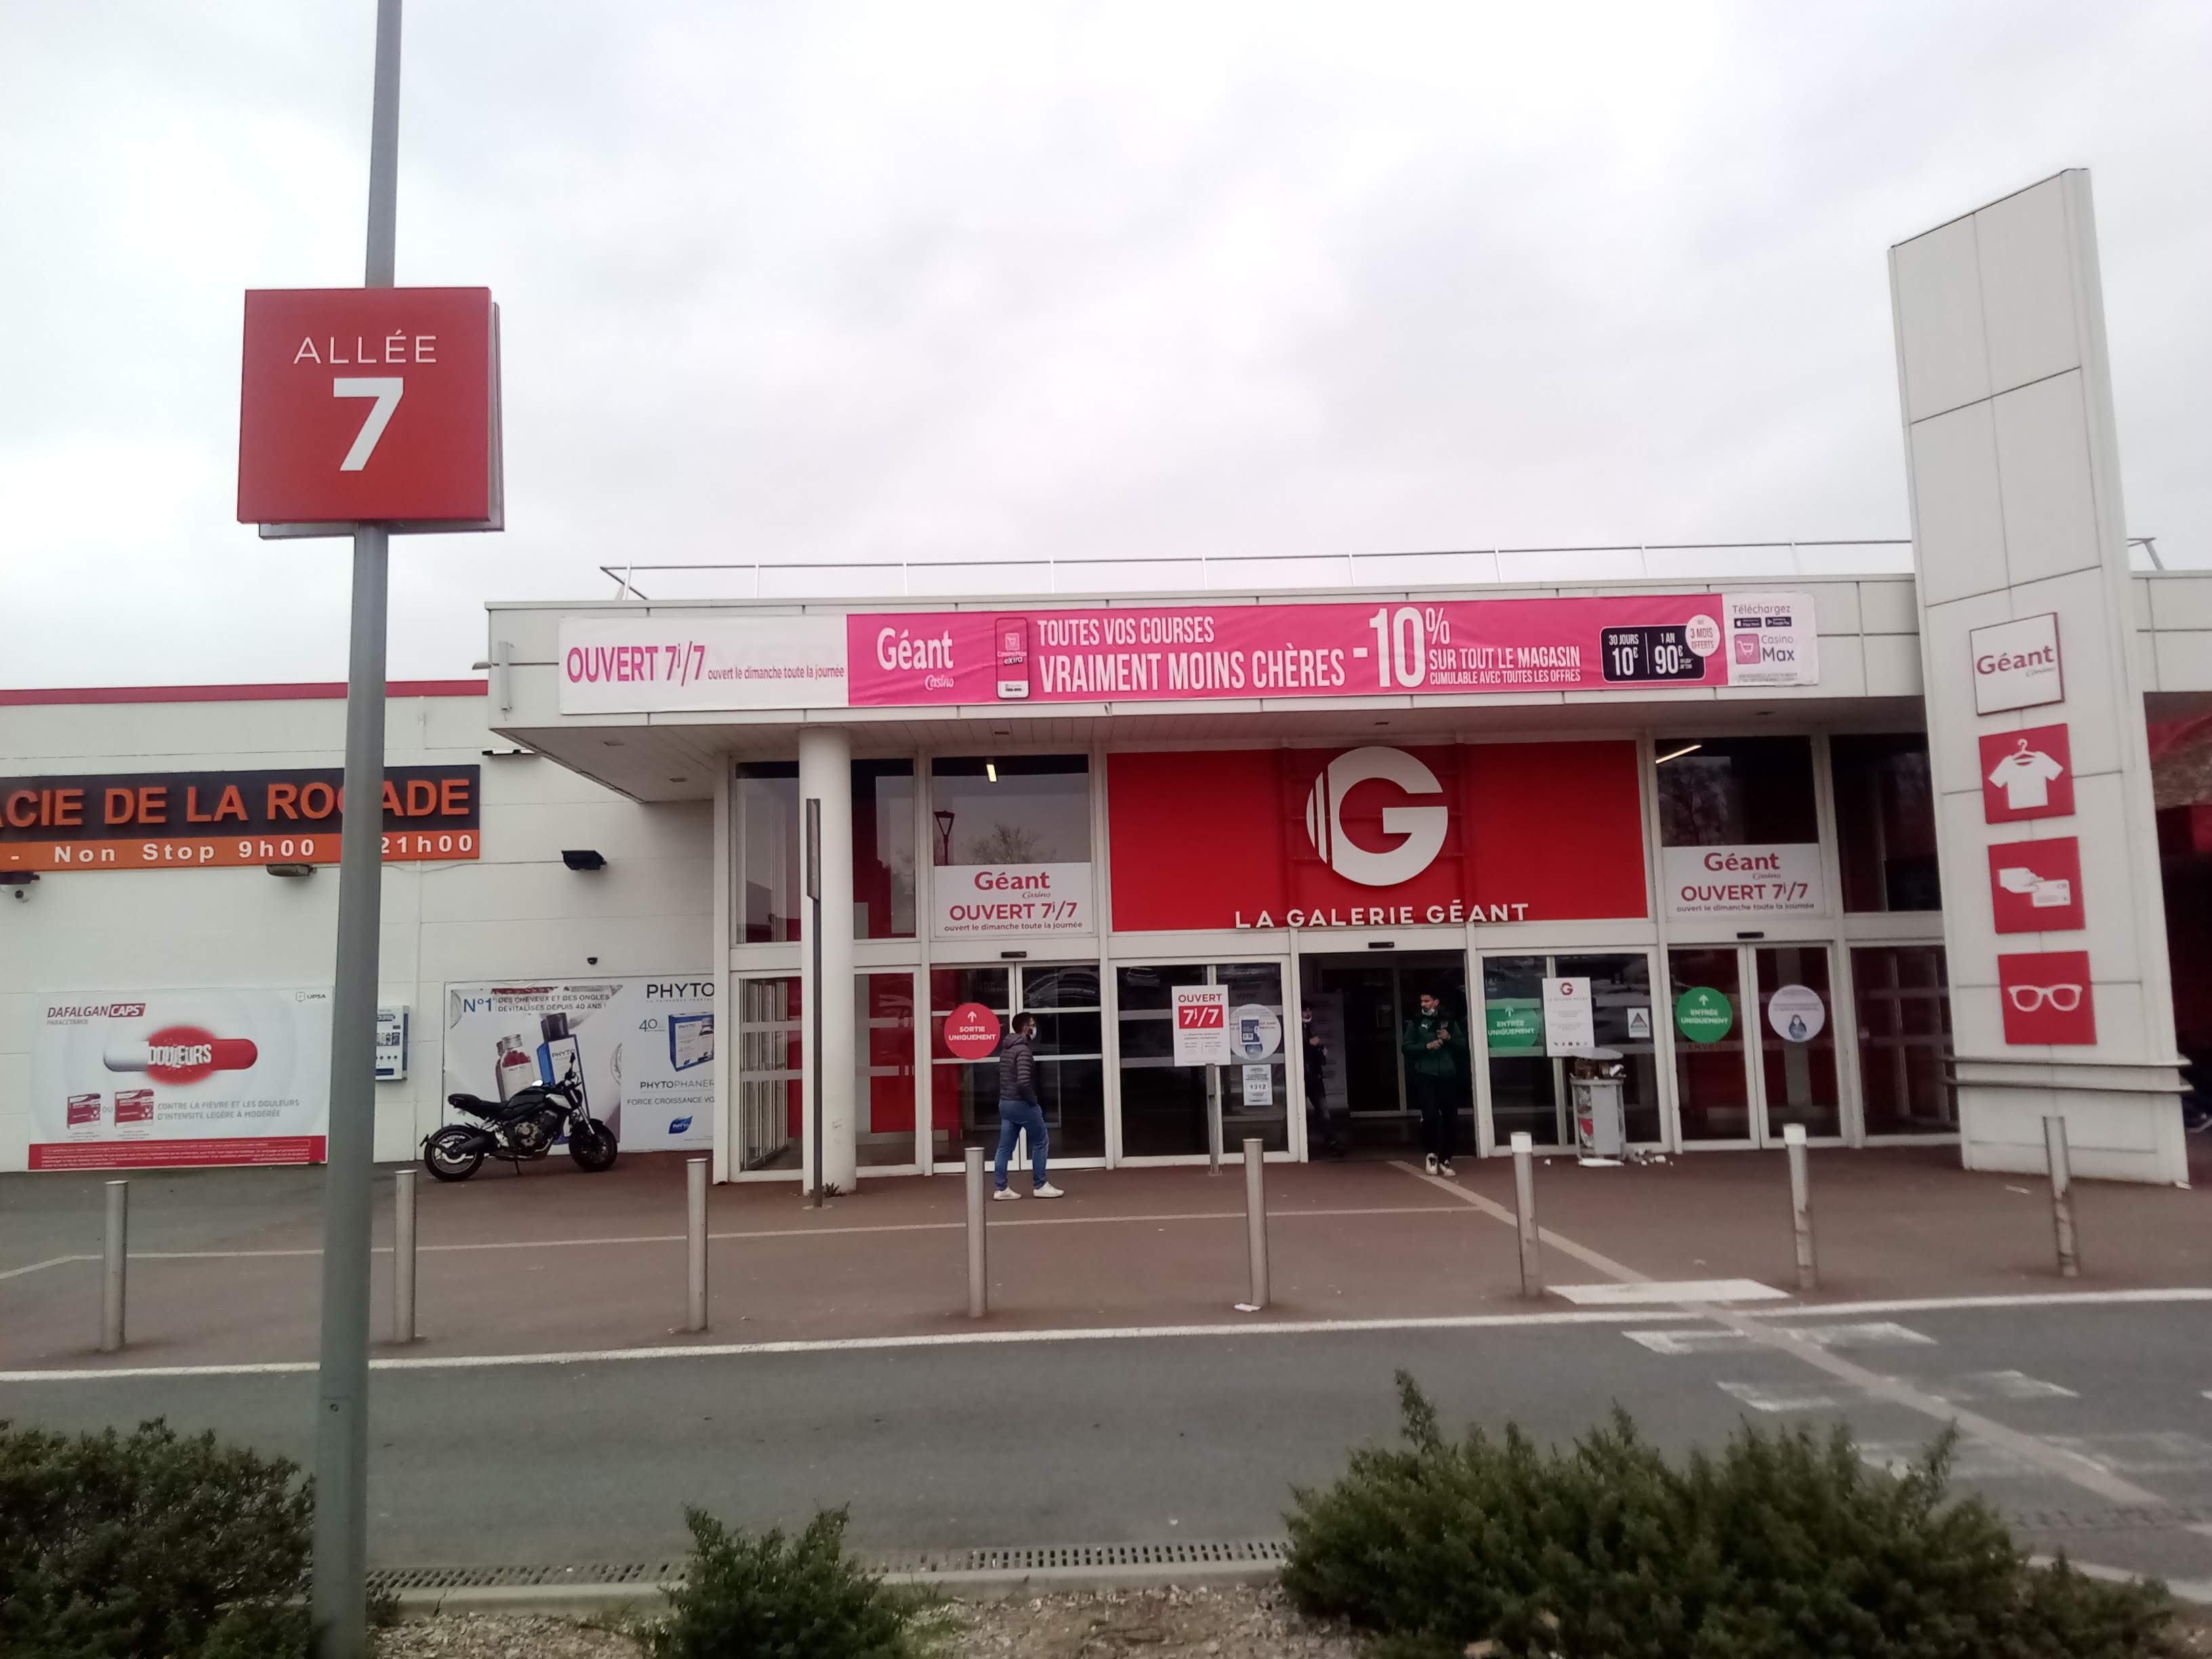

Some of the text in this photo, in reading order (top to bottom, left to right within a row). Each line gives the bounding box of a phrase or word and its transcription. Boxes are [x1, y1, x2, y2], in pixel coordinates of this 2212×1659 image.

[293, 329, 437, 364] ALLÉE
[333, 377, 404, 472] 7
[1732, 605, 1791, 615] Téléchargez
[1037, 615, 1214, 646] TOUTES VOS COURSES
[1660, 632, 1675, 644] 1 AN
[1690, 628, 1713, 638] 3 MOIS
[1608, 634, 1639, 646] 30 JOURS
[1692, 640, 1714, 649] OFFERTS
[1761, 634, 1794, 644] Casino
[877, 628, 954, 671] Géant
[1763, 647, 1795, 662] Max
[567, 646, 658, 683] OUVERT
[1429, 646, 1580, 670] SUR TOUT LE MAGASIN
[1976, 645, 2055, 675] Géant
[708, 663, 844, 680] ouvert le dimanche toute la journée
[1039, 642, 1345, 693] VRAIMENT MOINS CHÈRES
[924, 674, 954, 691] Casino
[1430, 669, 1580, 685] CUMULABLE AVEC TOUTES LES OFFRES
[0, 779, 470, 828] CIE DE LA ROADE
[1307, 746, 1448, 886] G
[54, 846, 115, 863] Non
[142, 842, 215, 863] Stop
[239, 839, 314, 858] 9h00
[1704, 853, 1780, 872] Géant
[975, 872, 1050, 890] Géant
[1022, 891, 1051, 899] Casino
[1681, 884, 1766, 901] OUVERT
[949, 903, 1036, 921] OUVERT
[1235, 899, 1529, 928] LA GALERIE GÉANT
[1713, 903, 1751, 912] dimanche
[1052, 922, 1082, 930] journée
[647, 983, 714, 999] PHYTO
[1560, 983, 1574, 996] G
[464, 998, 492, 1012] N°1
[1179, 994, 1223, 1003] OUVERT
[47, 1004, 141, 1018] DAFALGAN CAPS
[546, 1003, 573, 1011] DEPUIS
[639, 1019, 657, 1032] 40
[1488, 1027, 1534, 1036] UNIQUEMENT
[148, 1044, 211, 1068] DOULEURS
[157, 1102, 187, 1110] CONTRE
[202, 1100, 228, 1109] FIÈVRE
[258, 1099, 300, 1107] DOULEURS
[654, 1097, 702, 1105] CROISSANCE
